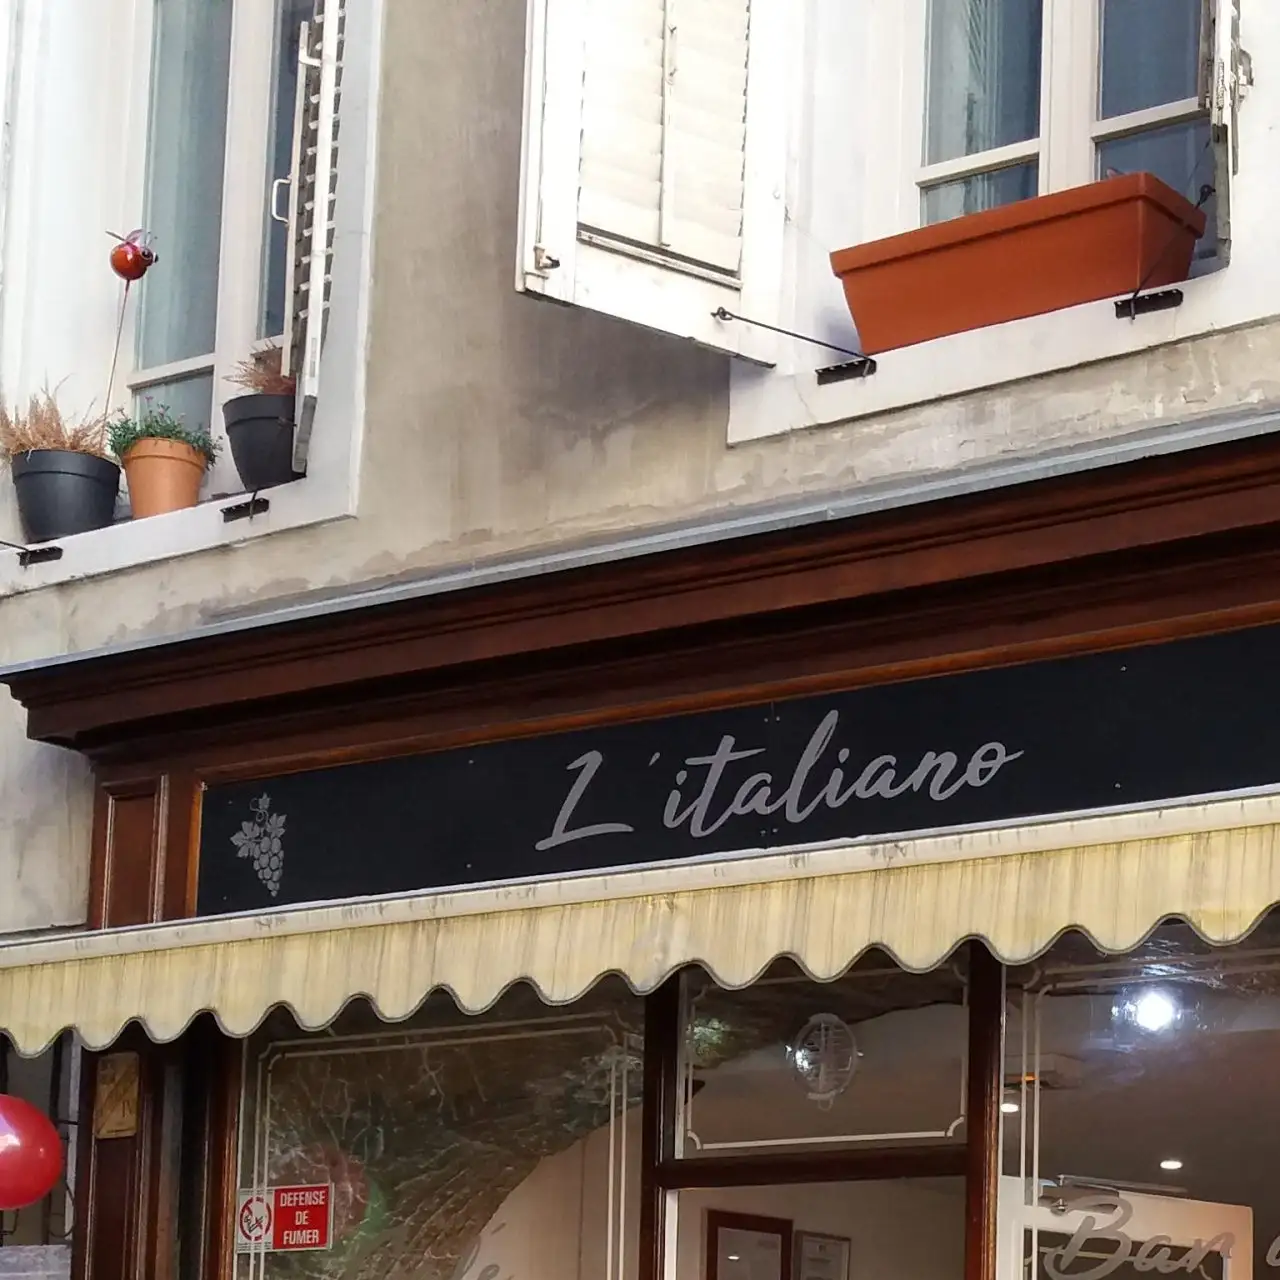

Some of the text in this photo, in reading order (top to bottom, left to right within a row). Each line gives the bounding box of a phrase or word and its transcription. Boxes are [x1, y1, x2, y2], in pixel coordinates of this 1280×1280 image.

[535, 709, 1023, 852] L'italiano
[280, 1190, 326, 1207] DEFENSE
[295, 1211, 309, 1226] DE
[283, 1229, 319, 1245] FUMER
